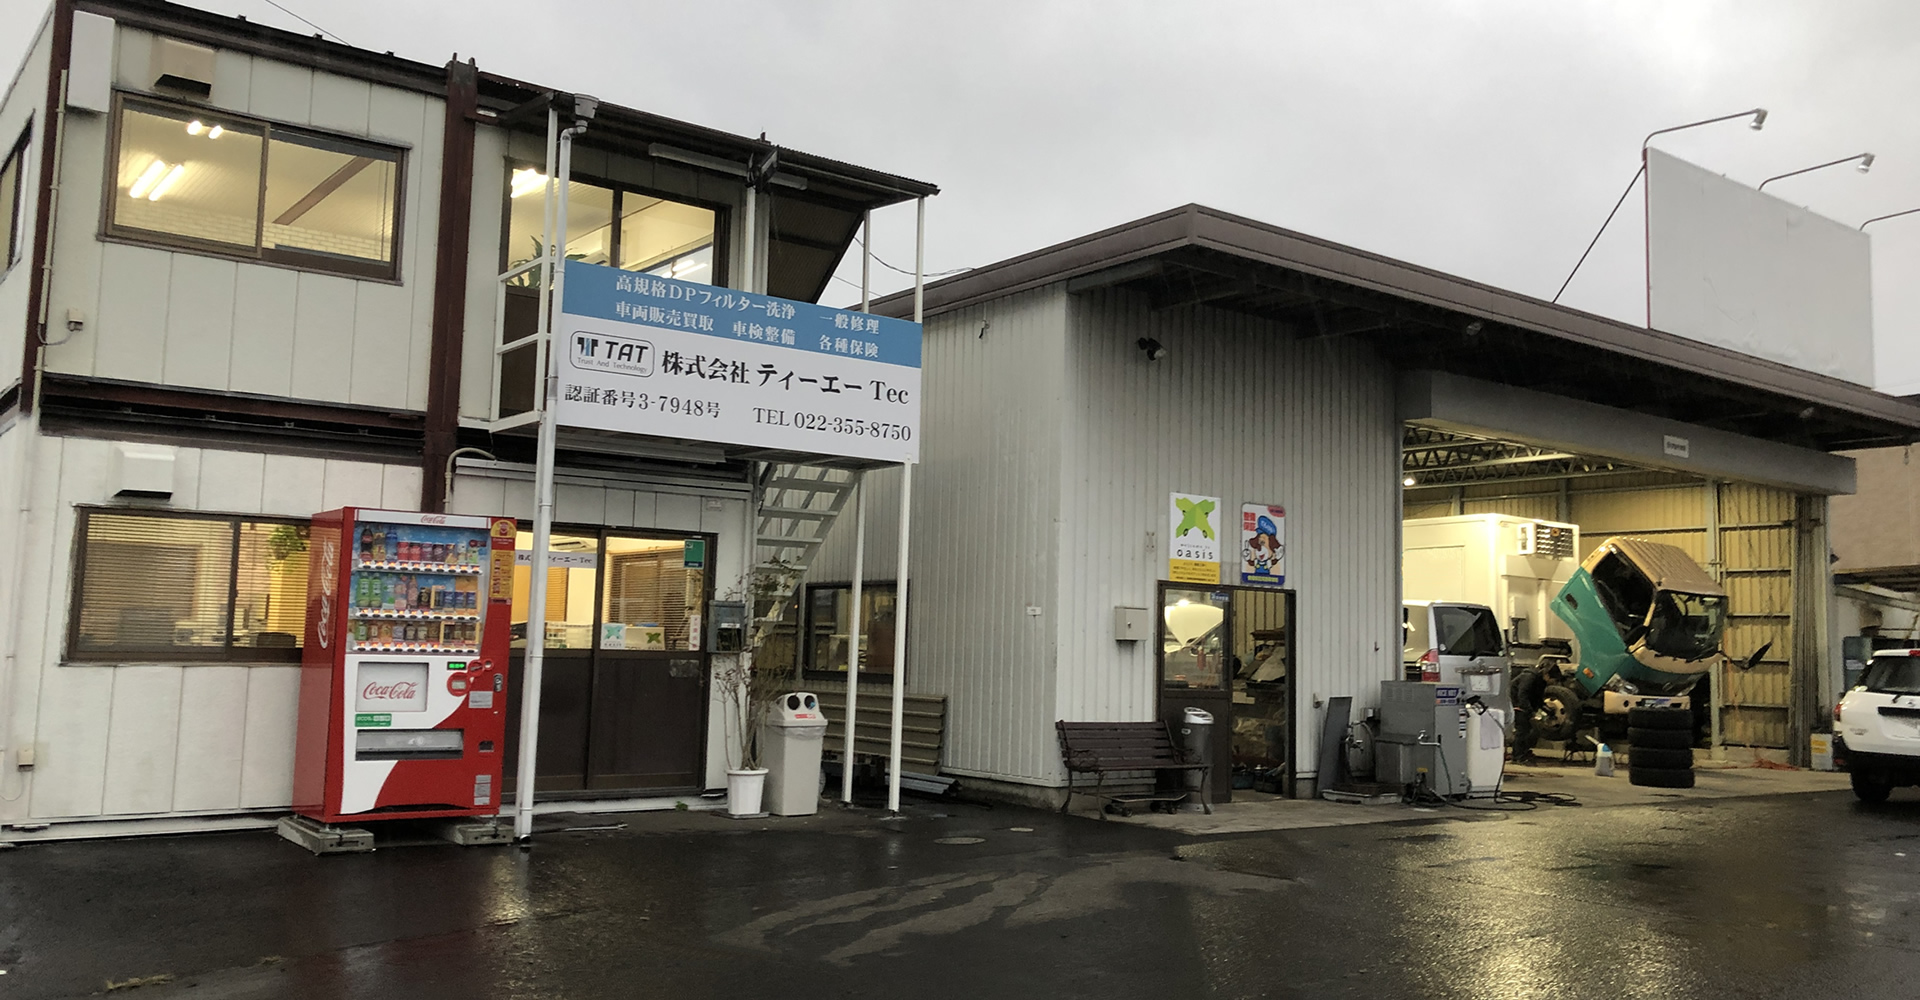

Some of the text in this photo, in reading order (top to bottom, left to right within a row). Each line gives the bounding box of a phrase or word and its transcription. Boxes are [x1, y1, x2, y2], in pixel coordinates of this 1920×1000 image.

[616, 274, 880, 335] 高規格DPフィルター洗浄 一般修理
[616, 301, 879, 358] 車両販売買取 車検整備 各種保険
[577, 356, 648, 373] Trust And Technology
[605, 341, 649, 363] TAT
[661, 350, 910, 405] 株式会社 ティーエー Tec
[565, 384, 721, 419] 認証番号3-7948号
[753, 407, 912, 441] TEL 022-355-8750
[1176, 549, 1214, 560] oasis
[318, 536, 334, 649] Coca-Cola
[363, 681, 418, 700] Coca-Cola
